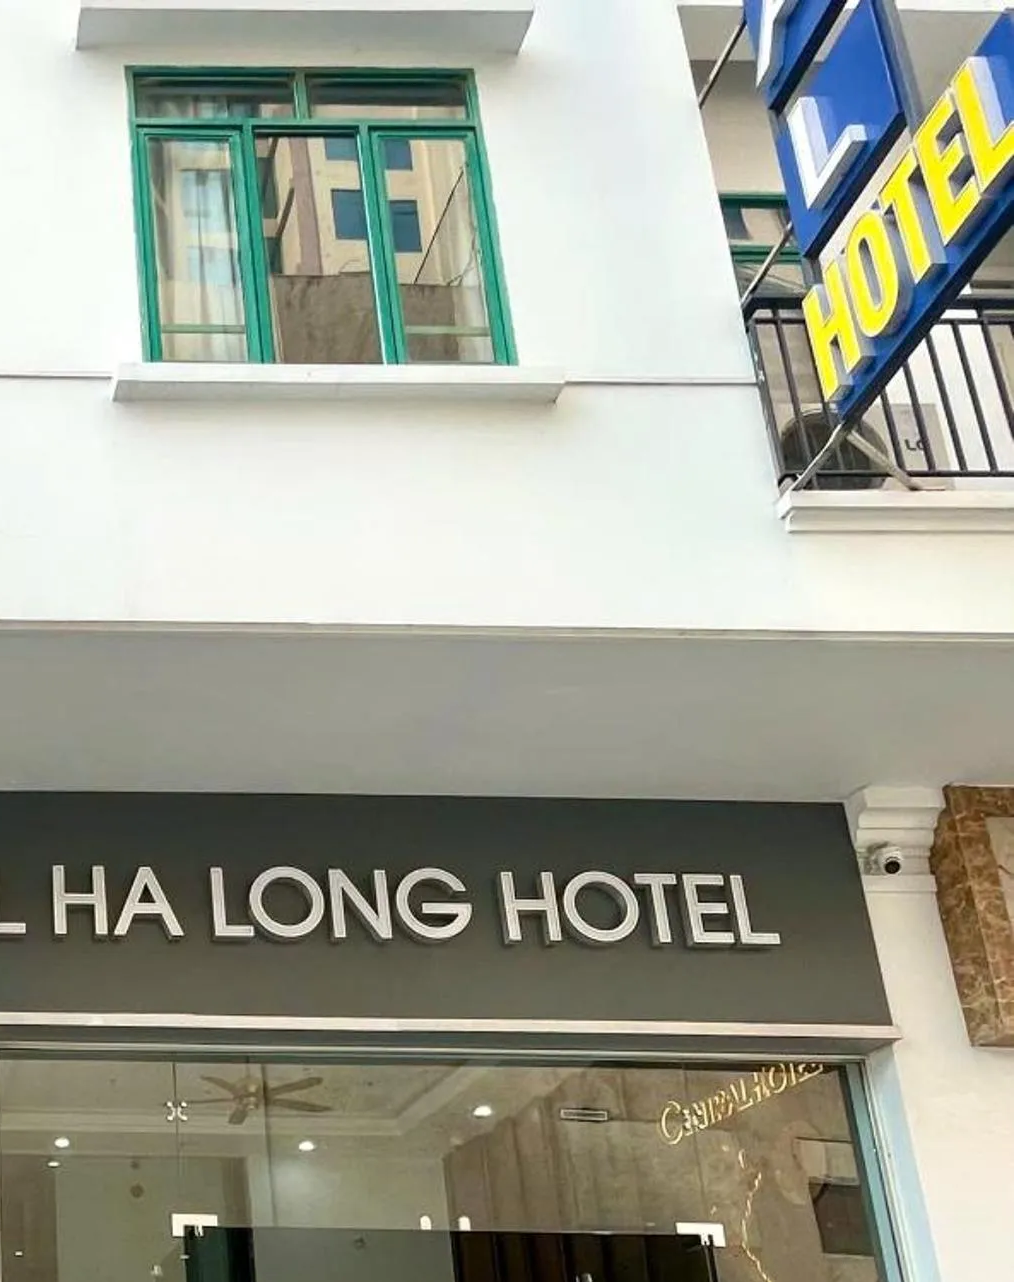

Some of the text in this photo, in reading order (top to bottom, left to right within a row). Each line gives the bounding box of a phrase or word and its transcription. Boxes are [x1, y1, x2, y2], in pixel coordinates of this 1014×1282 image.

[802, 57, 1014, 401] HOTEL
[52, 864, 185, 939] HA
[209, 866, 472, 943] LONG
[499, 870, 782, 949] HOTEL
